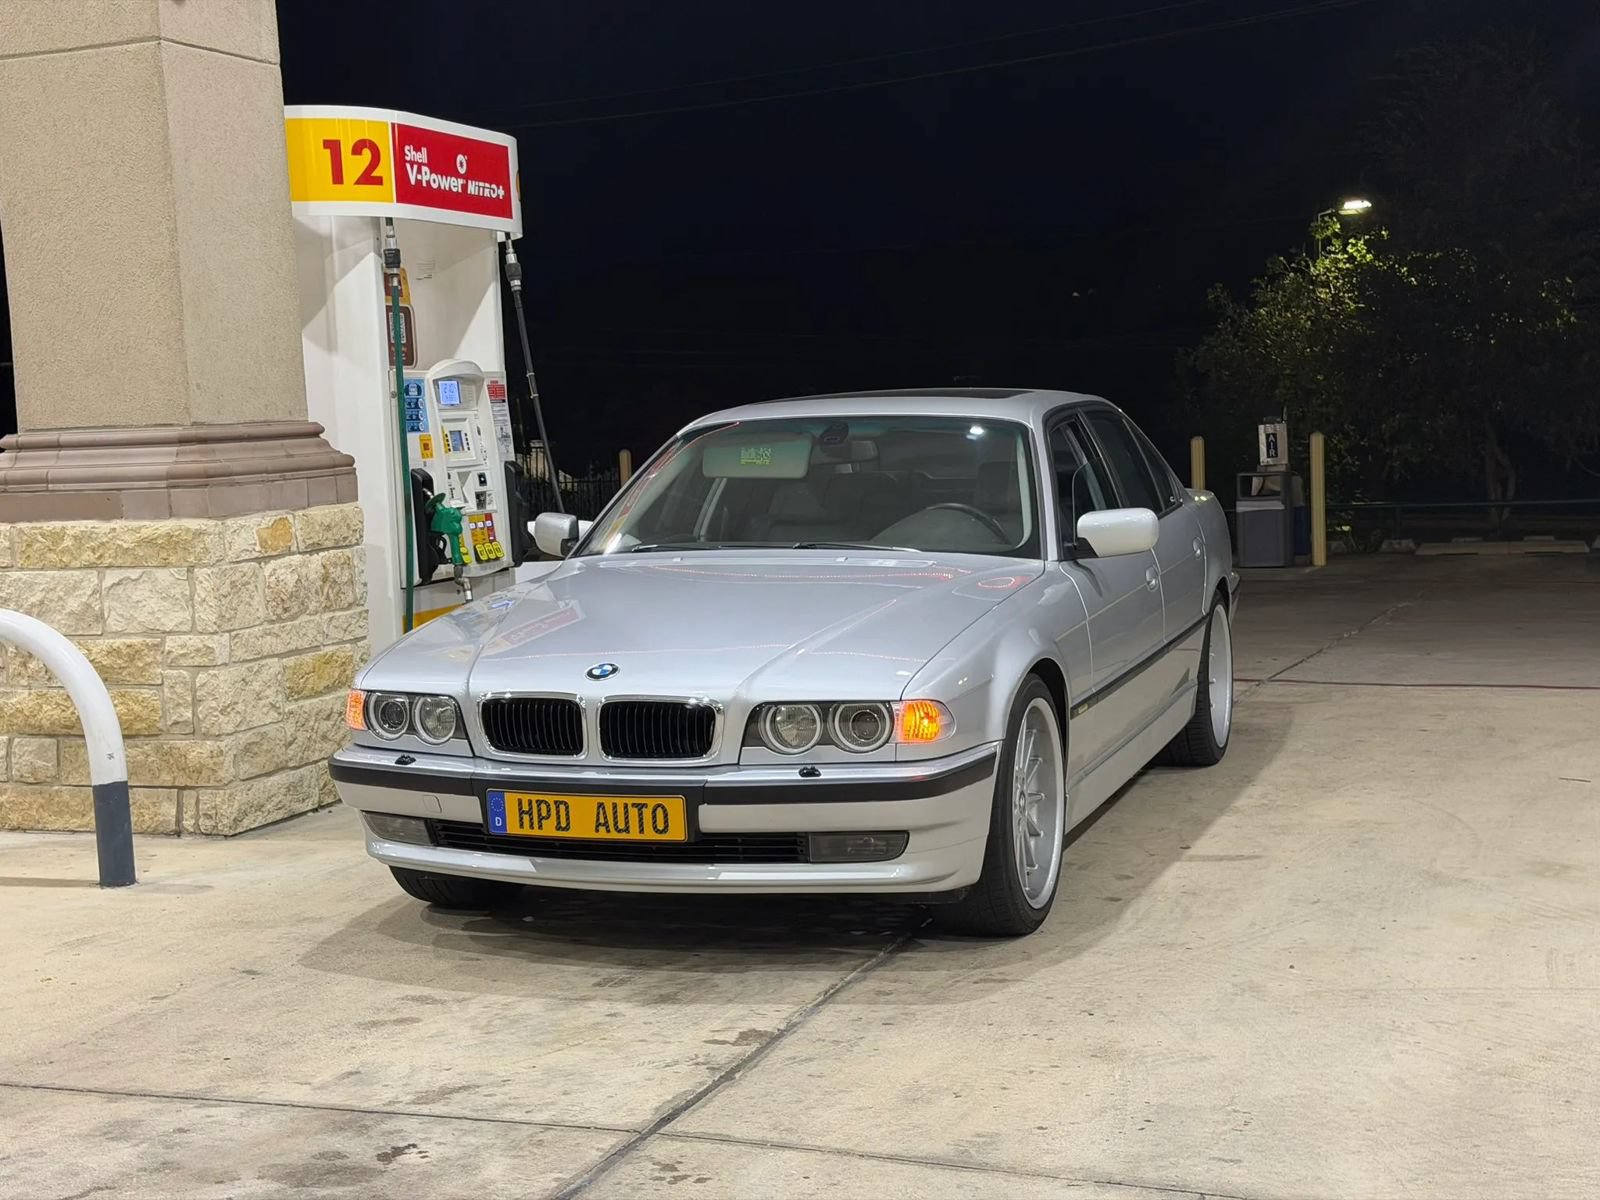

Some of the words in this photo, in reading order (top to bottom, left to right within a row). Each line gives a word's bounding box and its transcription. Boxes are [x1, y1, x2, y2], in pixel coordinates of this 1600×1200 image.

[322, 138, 384, 186] 12
[404, 145, 428, 164] Shell
[405, 163, 463, 193] V-Power
[1268, 433, 1276, 457] AIR
[517, 798, 571, 832] HPD
[594, 802, 669, 835] AUTO
